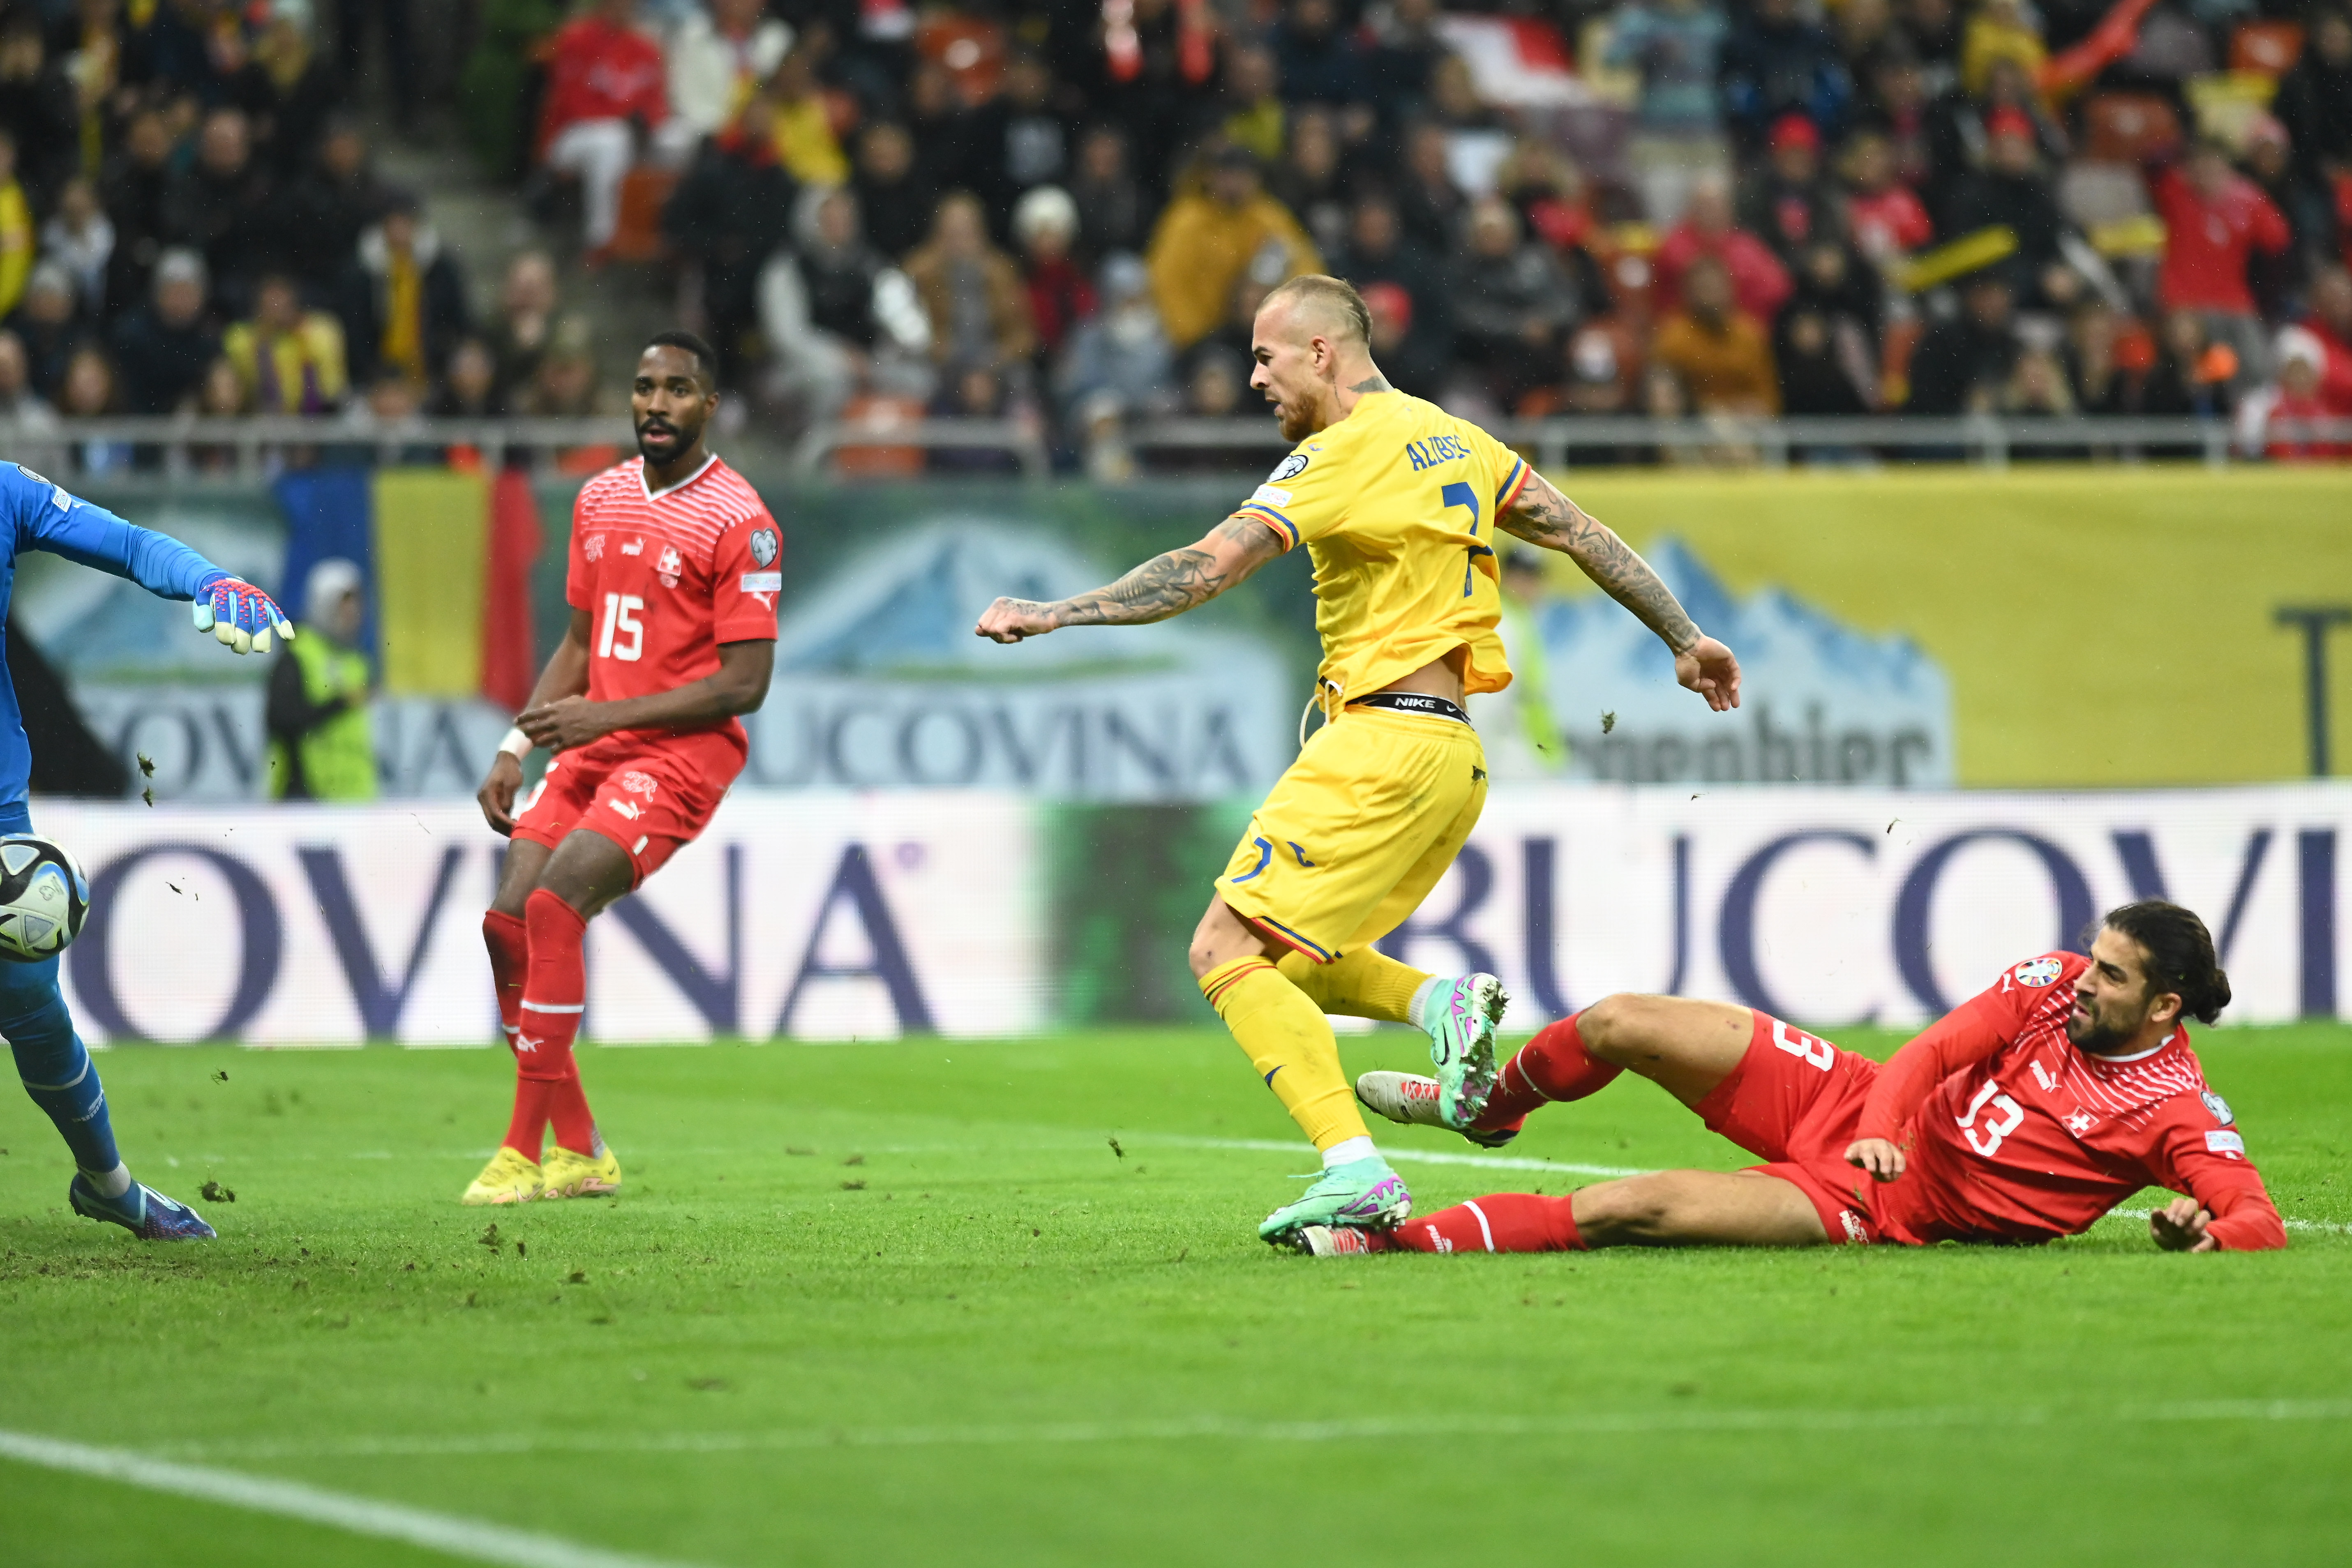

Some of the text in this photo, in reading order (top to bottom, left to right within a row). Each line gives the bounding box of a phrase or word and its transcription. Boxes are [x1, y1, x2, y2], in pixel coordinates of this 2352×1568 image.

[1441, 482, 1494, 598] 7
[599, 594, 644, 662] 15
[1395, 697, 1436, 709] NIKE
[1231, 837, 1273, 883] 7
[2029, 1059, 2052, 1091] PUMA
[1955, 1078, 2024, 1157] 13
